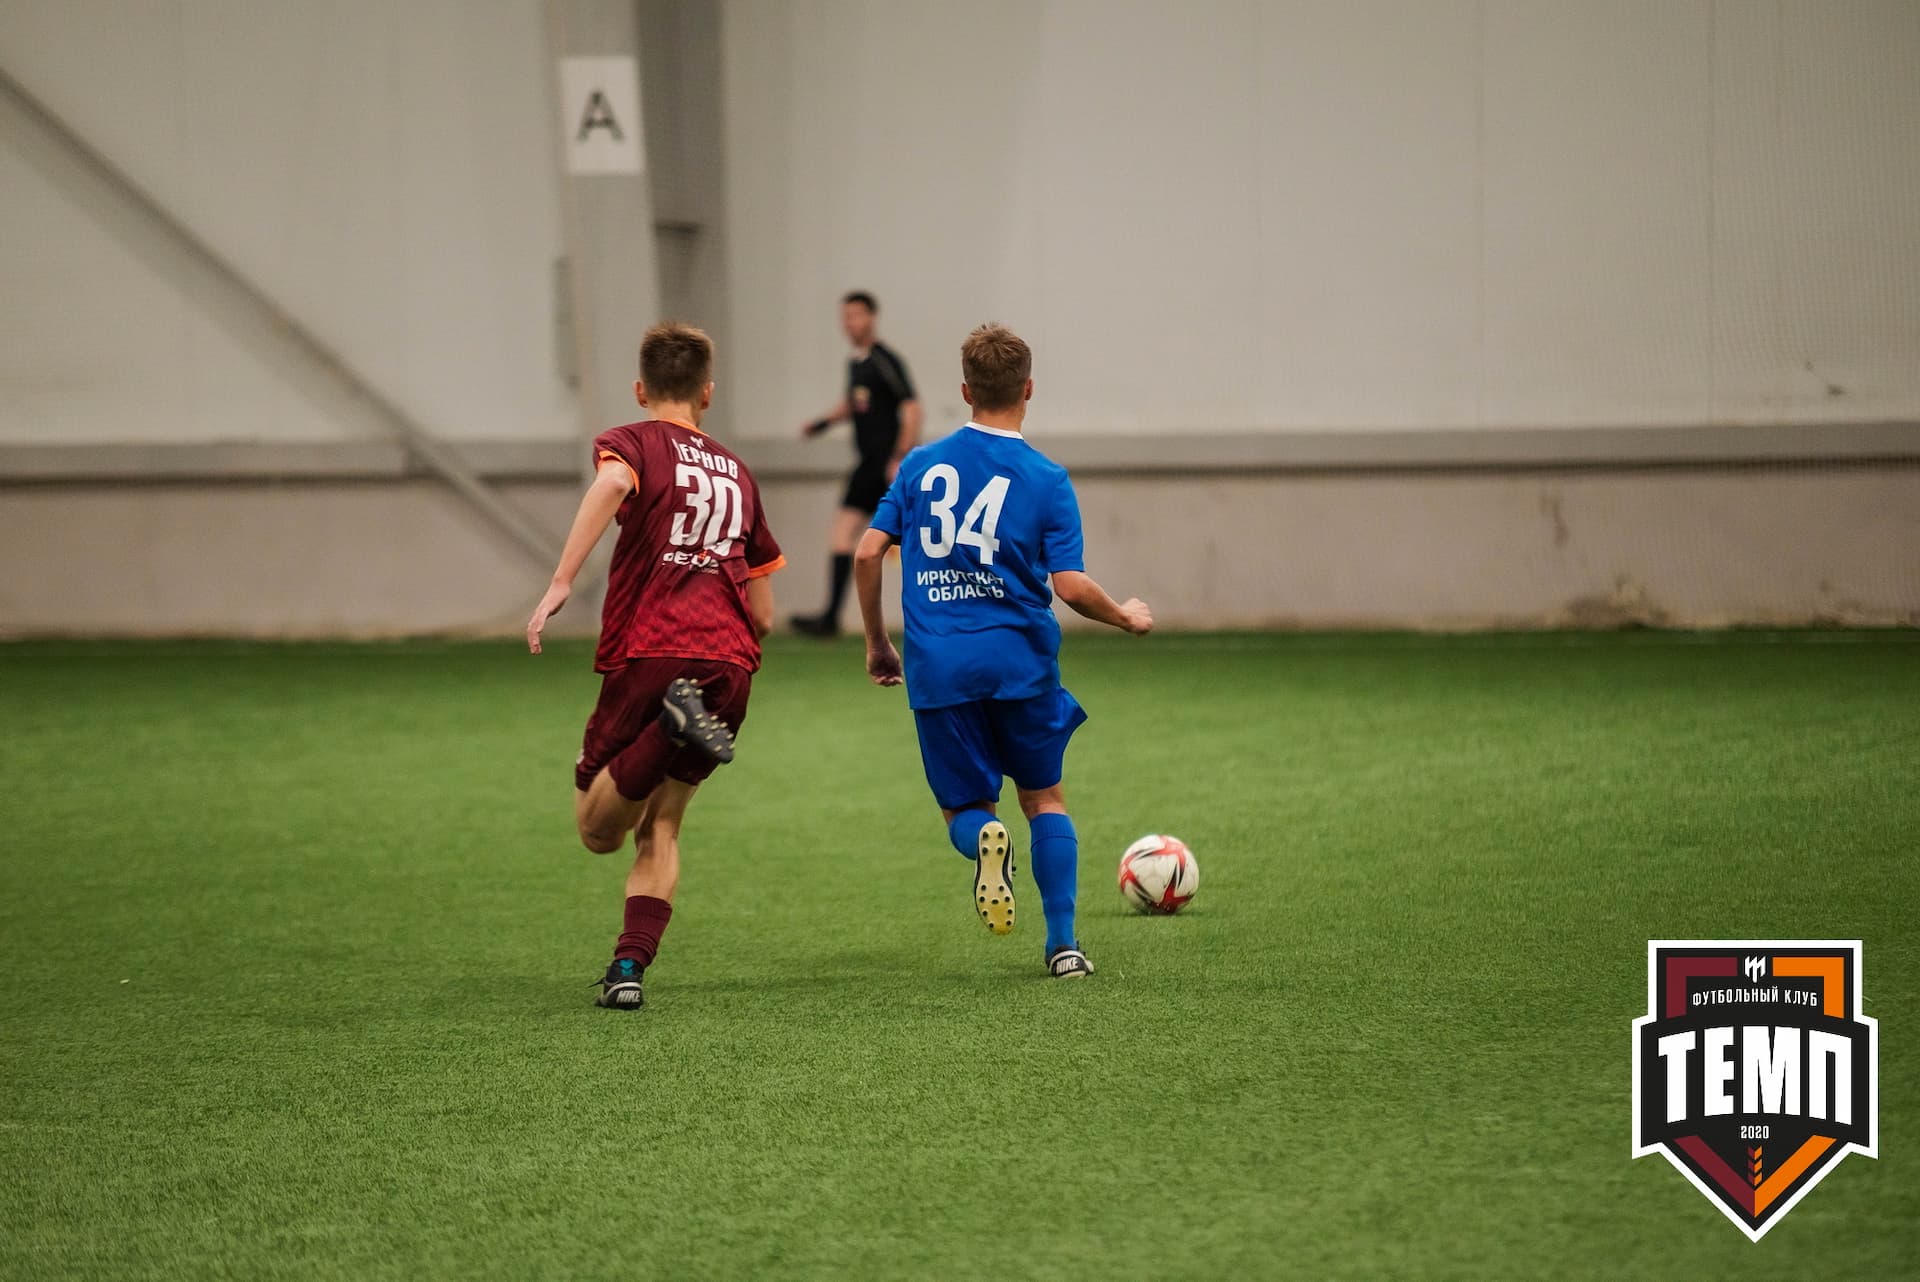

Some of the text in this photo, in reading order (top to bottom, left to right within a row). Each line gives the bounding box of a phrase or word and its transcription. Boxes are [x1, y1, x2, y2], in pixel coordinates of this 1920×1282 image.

[669, 463, 743, 557] 30
[919, 463, 1011, 565] 34
[928, 583, 1005, 602] ОБЛАСТЬ
[1056, 956, 1079, 976] NIKE
[616, 990, 641, 1003] NIKE
